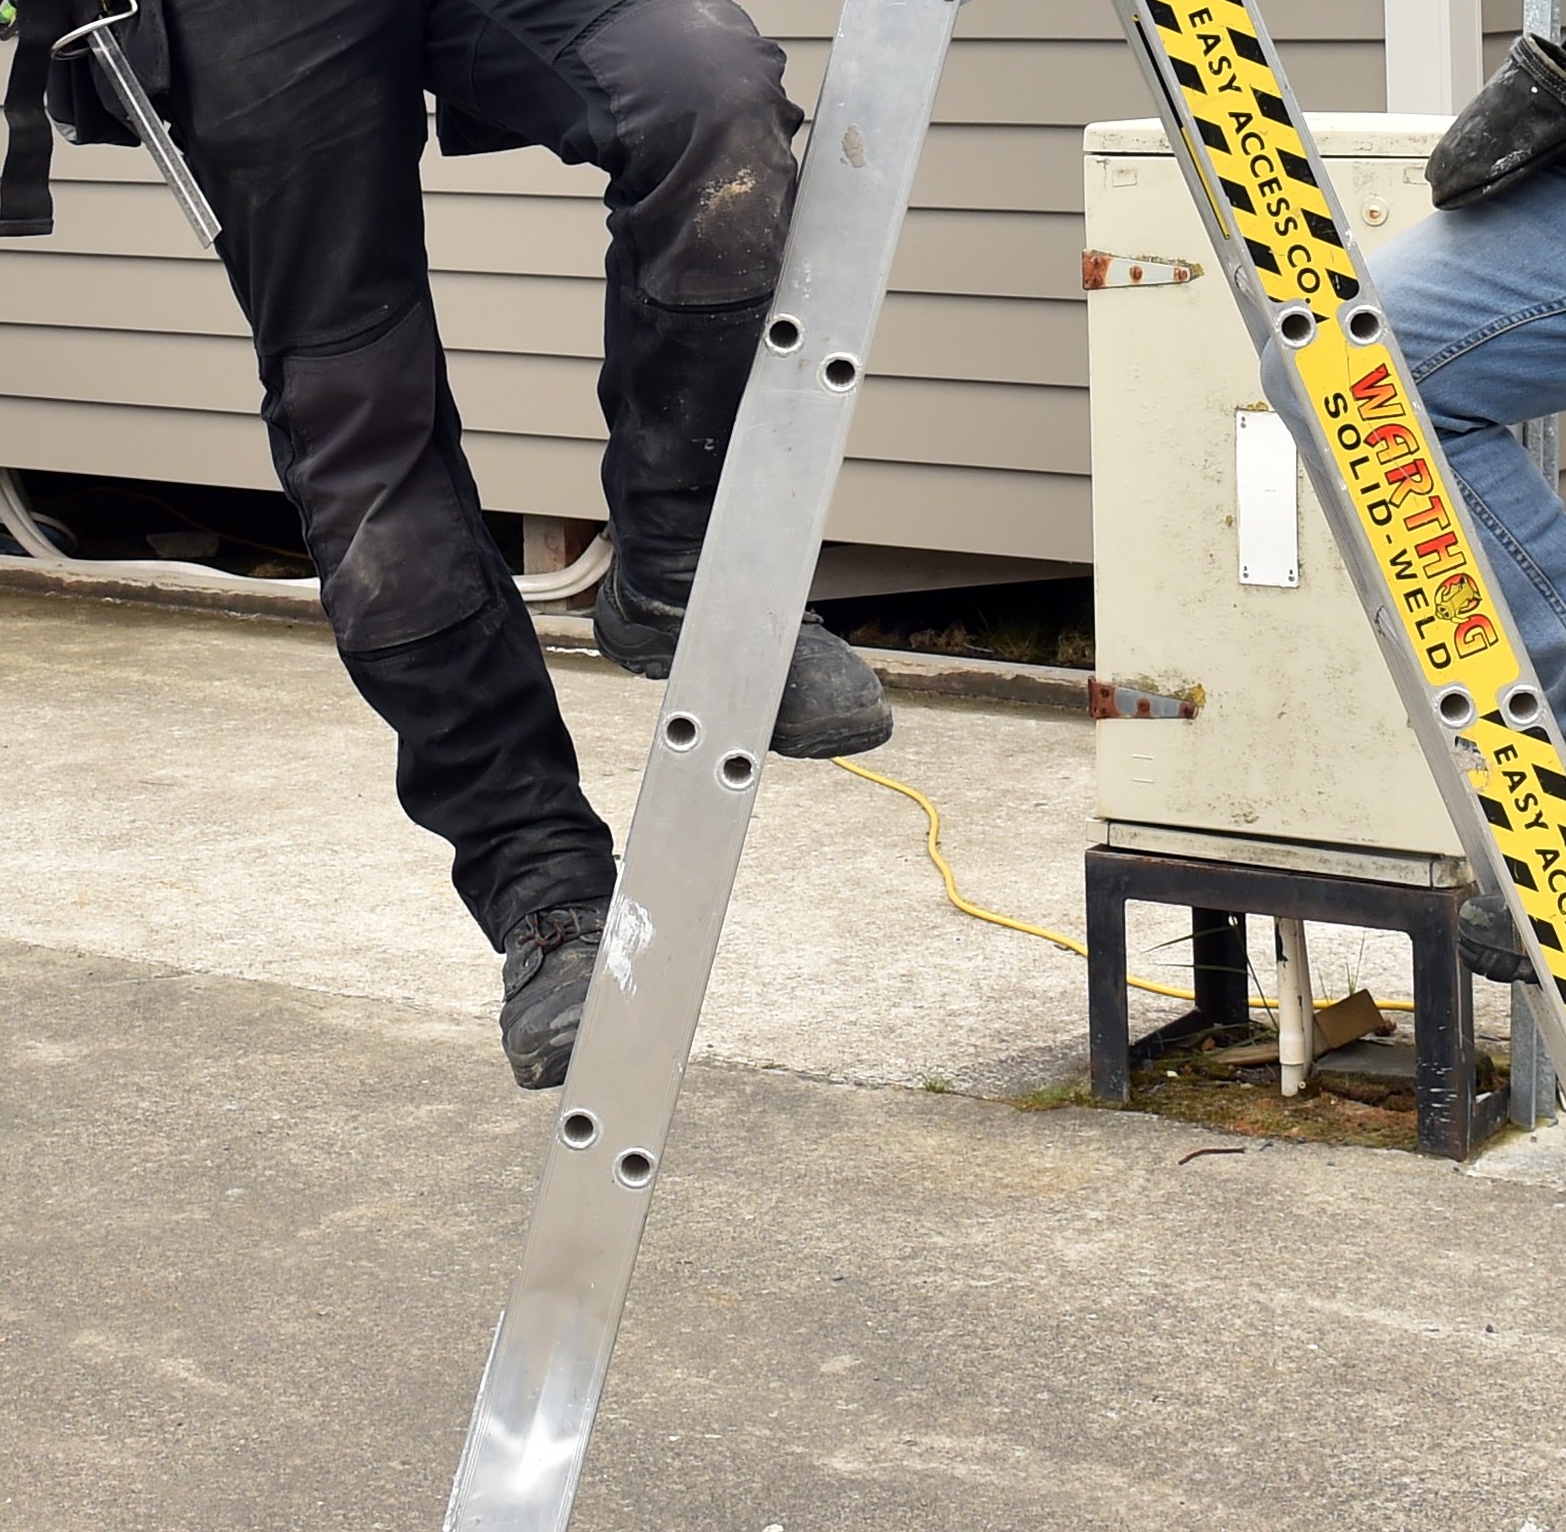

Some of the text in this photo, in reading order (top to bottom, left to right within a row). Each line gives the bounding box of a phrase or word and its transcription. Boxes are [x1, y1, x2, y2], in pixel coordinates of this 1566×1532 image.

[1188, 6, 1321, 305] EASY ACCESS CO.
[1323, 392, 1452, 670] SOLID-WELD
[1350, 363, 1499, 659] WARTHOG
[1493, 744, 1549, 830] EASY
